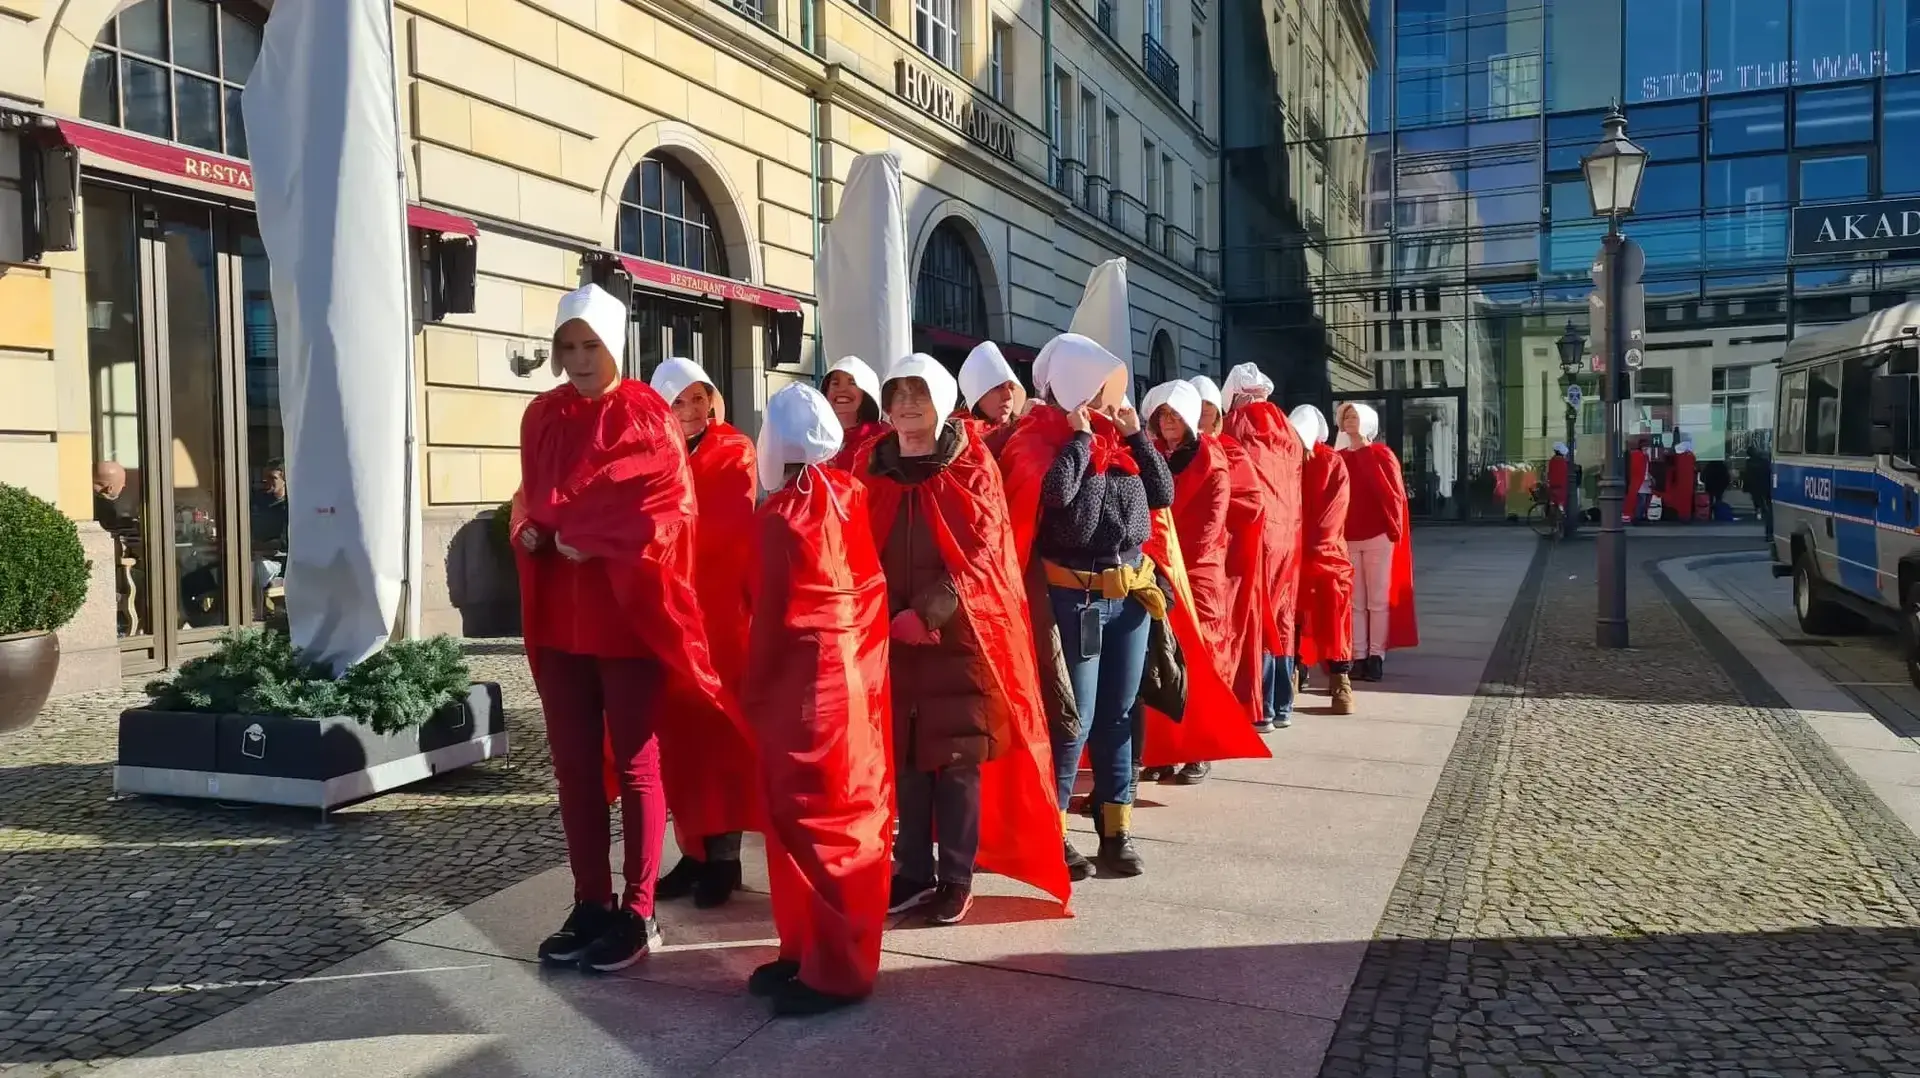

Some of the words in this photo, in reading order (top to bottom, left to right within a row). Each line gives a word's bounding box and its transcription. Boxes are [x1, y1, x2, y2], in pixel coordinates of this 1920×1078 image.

[1642, 69, 1723, 98] STOP
[1737, 60, 1799, 88] THE
[1813, 50, 1889, 80] WAR
[904, 63, 962, 130] HOTEL
[967, 101, 1016, 160] ADLON
[185, 157, 251, 187] RESTA
[1813, 210, 1920, 243] AKAD
[670, 272, 727, 296] RESTAURANT
[1804, 476, 1831, 502] POLIZEI
